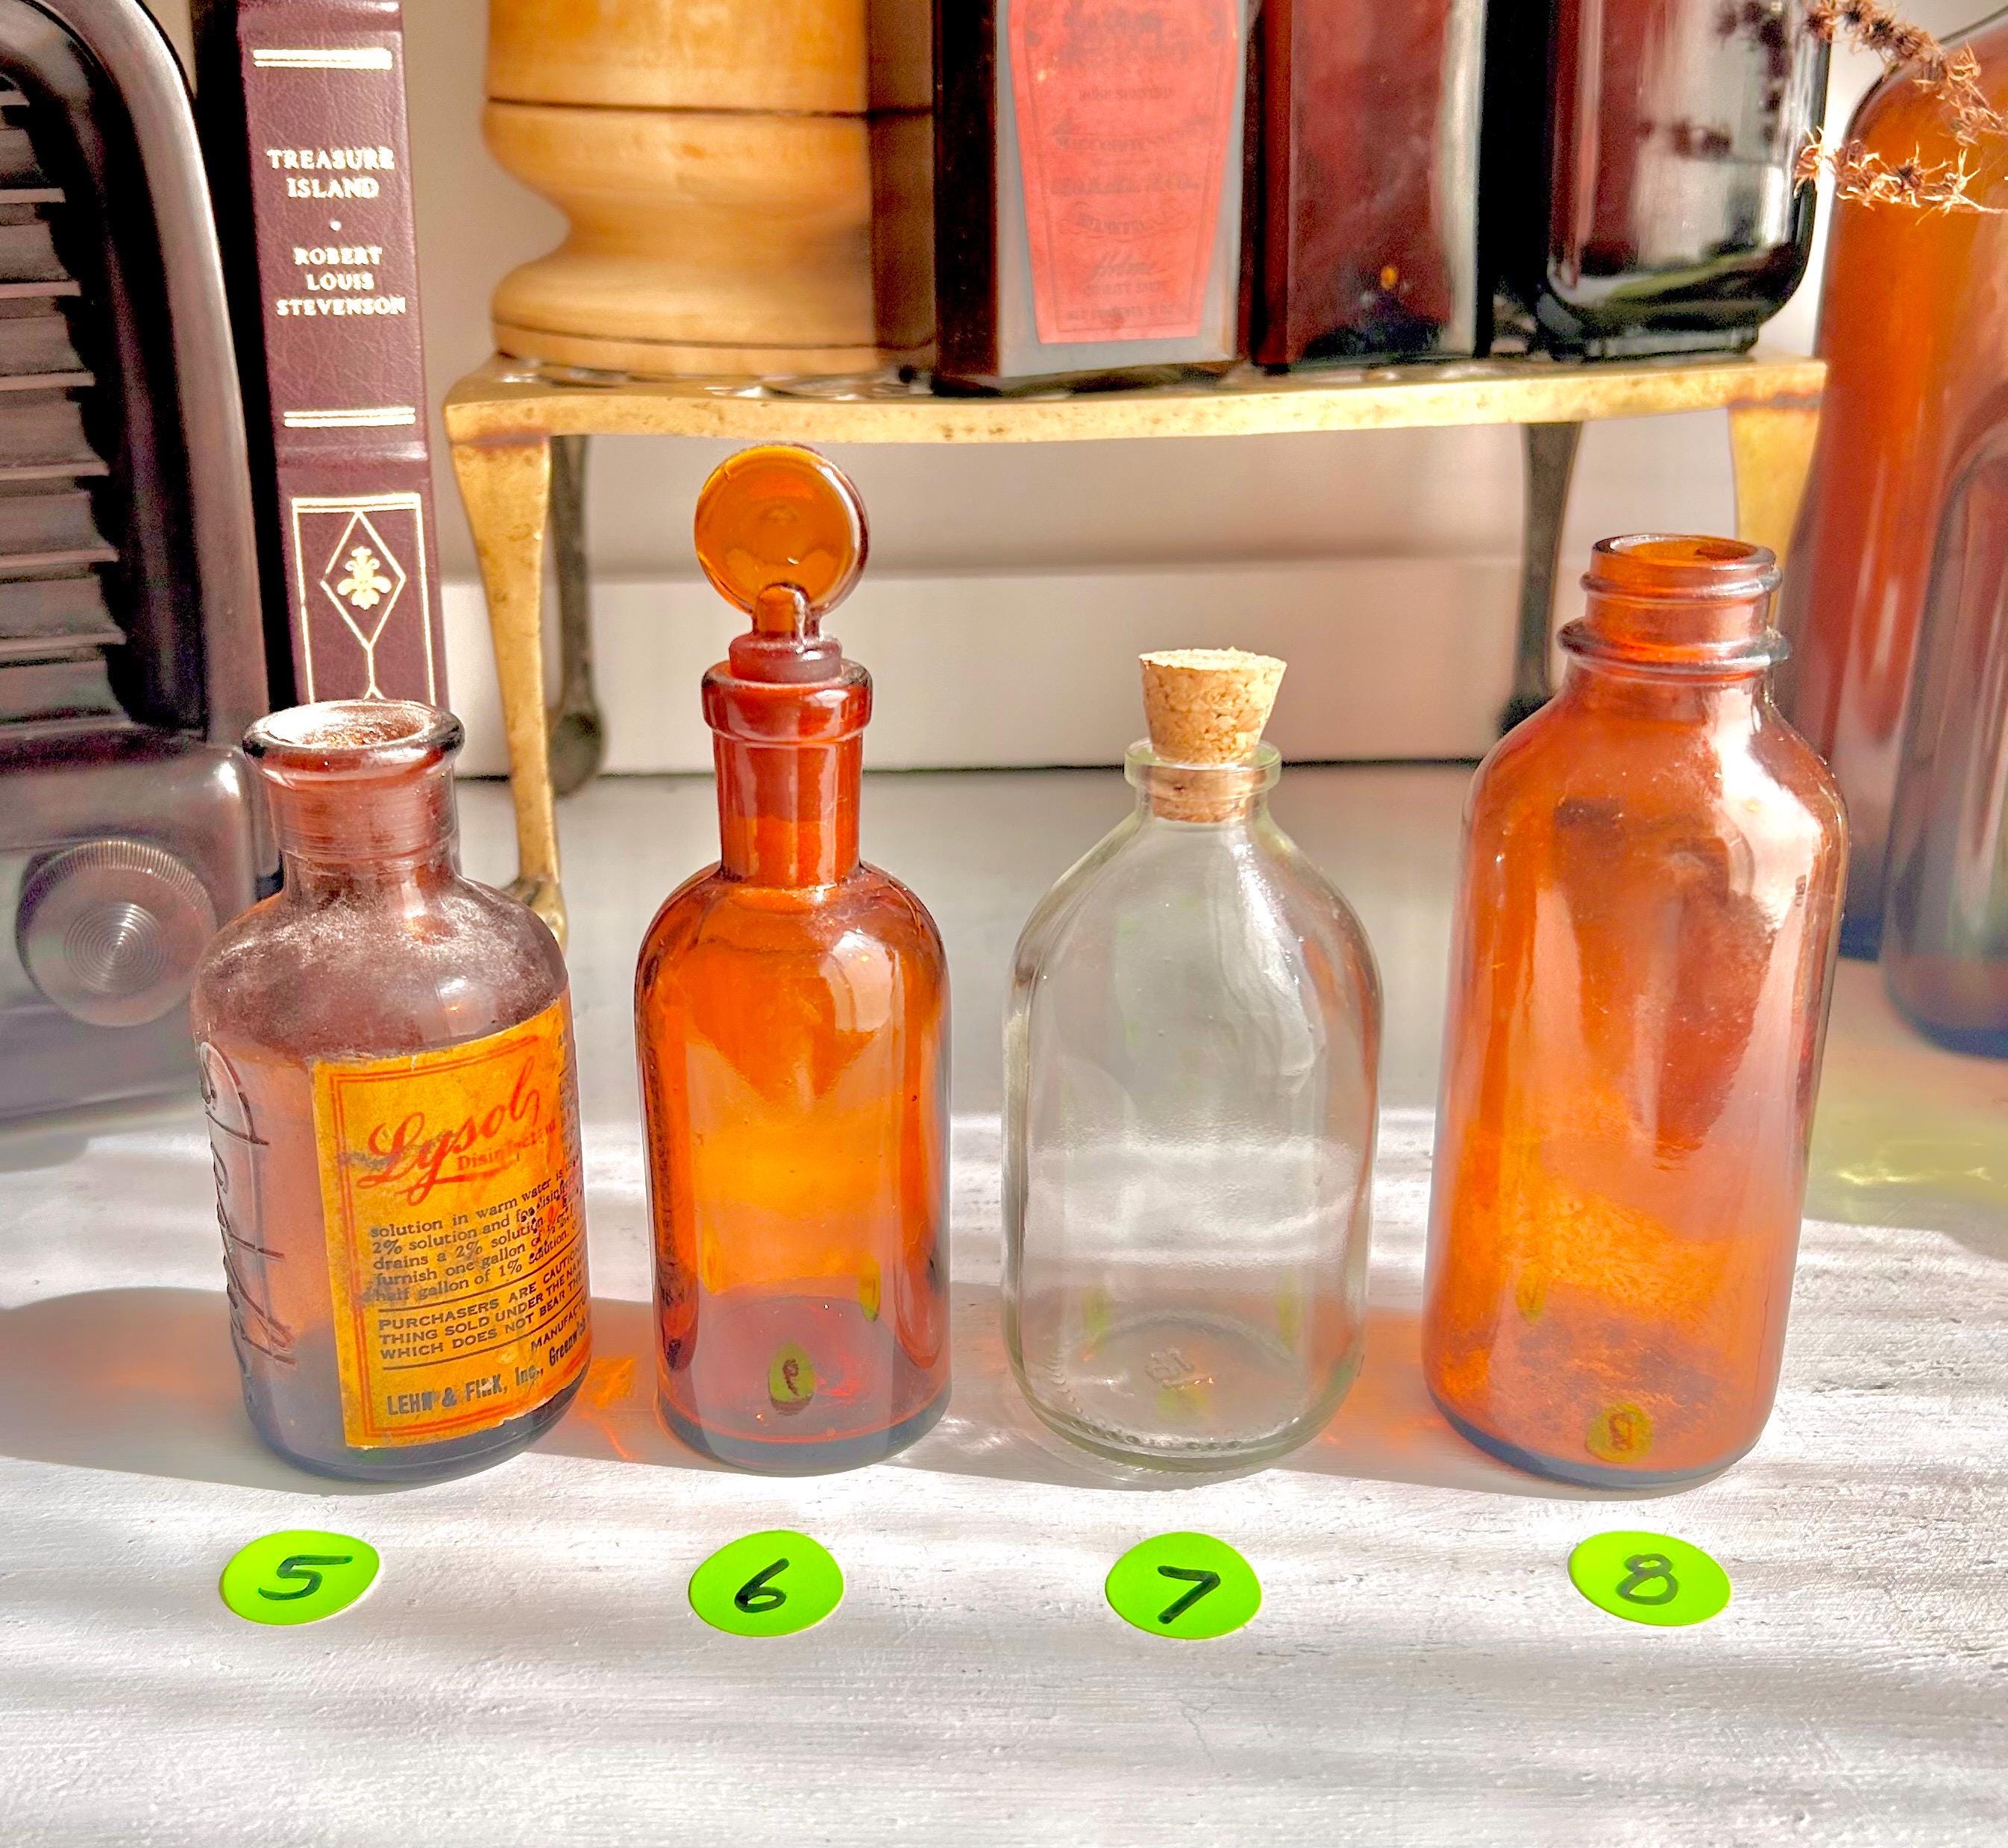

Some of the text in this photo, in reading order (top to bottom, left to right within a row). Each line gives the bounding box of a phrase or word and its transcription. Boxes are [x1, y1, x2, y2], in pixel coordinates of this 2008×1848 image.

[266, 148, 395, 170] TREASURE
[286, 177, 380, 198] ISLAND
[293, 246, 383, 266] ROBERT
[306, 272, 374, 292] LOUIS
[276, 297, 406, 316] STEVENSON
[357, 1056, 540, 1207] Lysol
[370, 1218, 442, 1238] solution
[452, 1214, 468, 1226] in
[476, 1197, 518, 1219] warm
[521, 1177, 551, 1202] water
[373, 1238, 403, 1255] 2%
[409, 1228, 477, 1250] solution
[482, 1213, 510, 1234] and
[373, 1255, 429, 1270] drains
[436, 1253, 447, 1262] a
[455, 1239, 483, 1259] 2%
[376, 1268, 438, 1285] furnish
[445, 1261, 475, 1277] one
[481, 1243, 526, 1269] gallon
[418, 1278, 469, 1300] gallon
[474, 1268, 491, 1285] of
[499, 1258, 523, 1277] 1%
[379, 1299, 500, 1331] PURCHASERS
[508, 1281, 537, 1305] ARE
[379, 1324, 439, 1345] THING
[444, 1315, 490, 1338] SOLD
[495, 1294, 544, 1324] UNDER
[545, 1274, 565, 1296] THE
[380, 1341, 445, 1360] WHICH
[452, 1326, 498, 1350] DOES
[504, 1313, 533, 1335] NOT
[539, 1290, 565, 1317] BEAR
[442, 1387, 457, 1408] &
[257, 1554, 354, 1600] 5
[734, 1557, 790, 1614] 6
[1158, 1564, 1221, 1624] 7
[1615, 1553, 1679, 1606] 8
